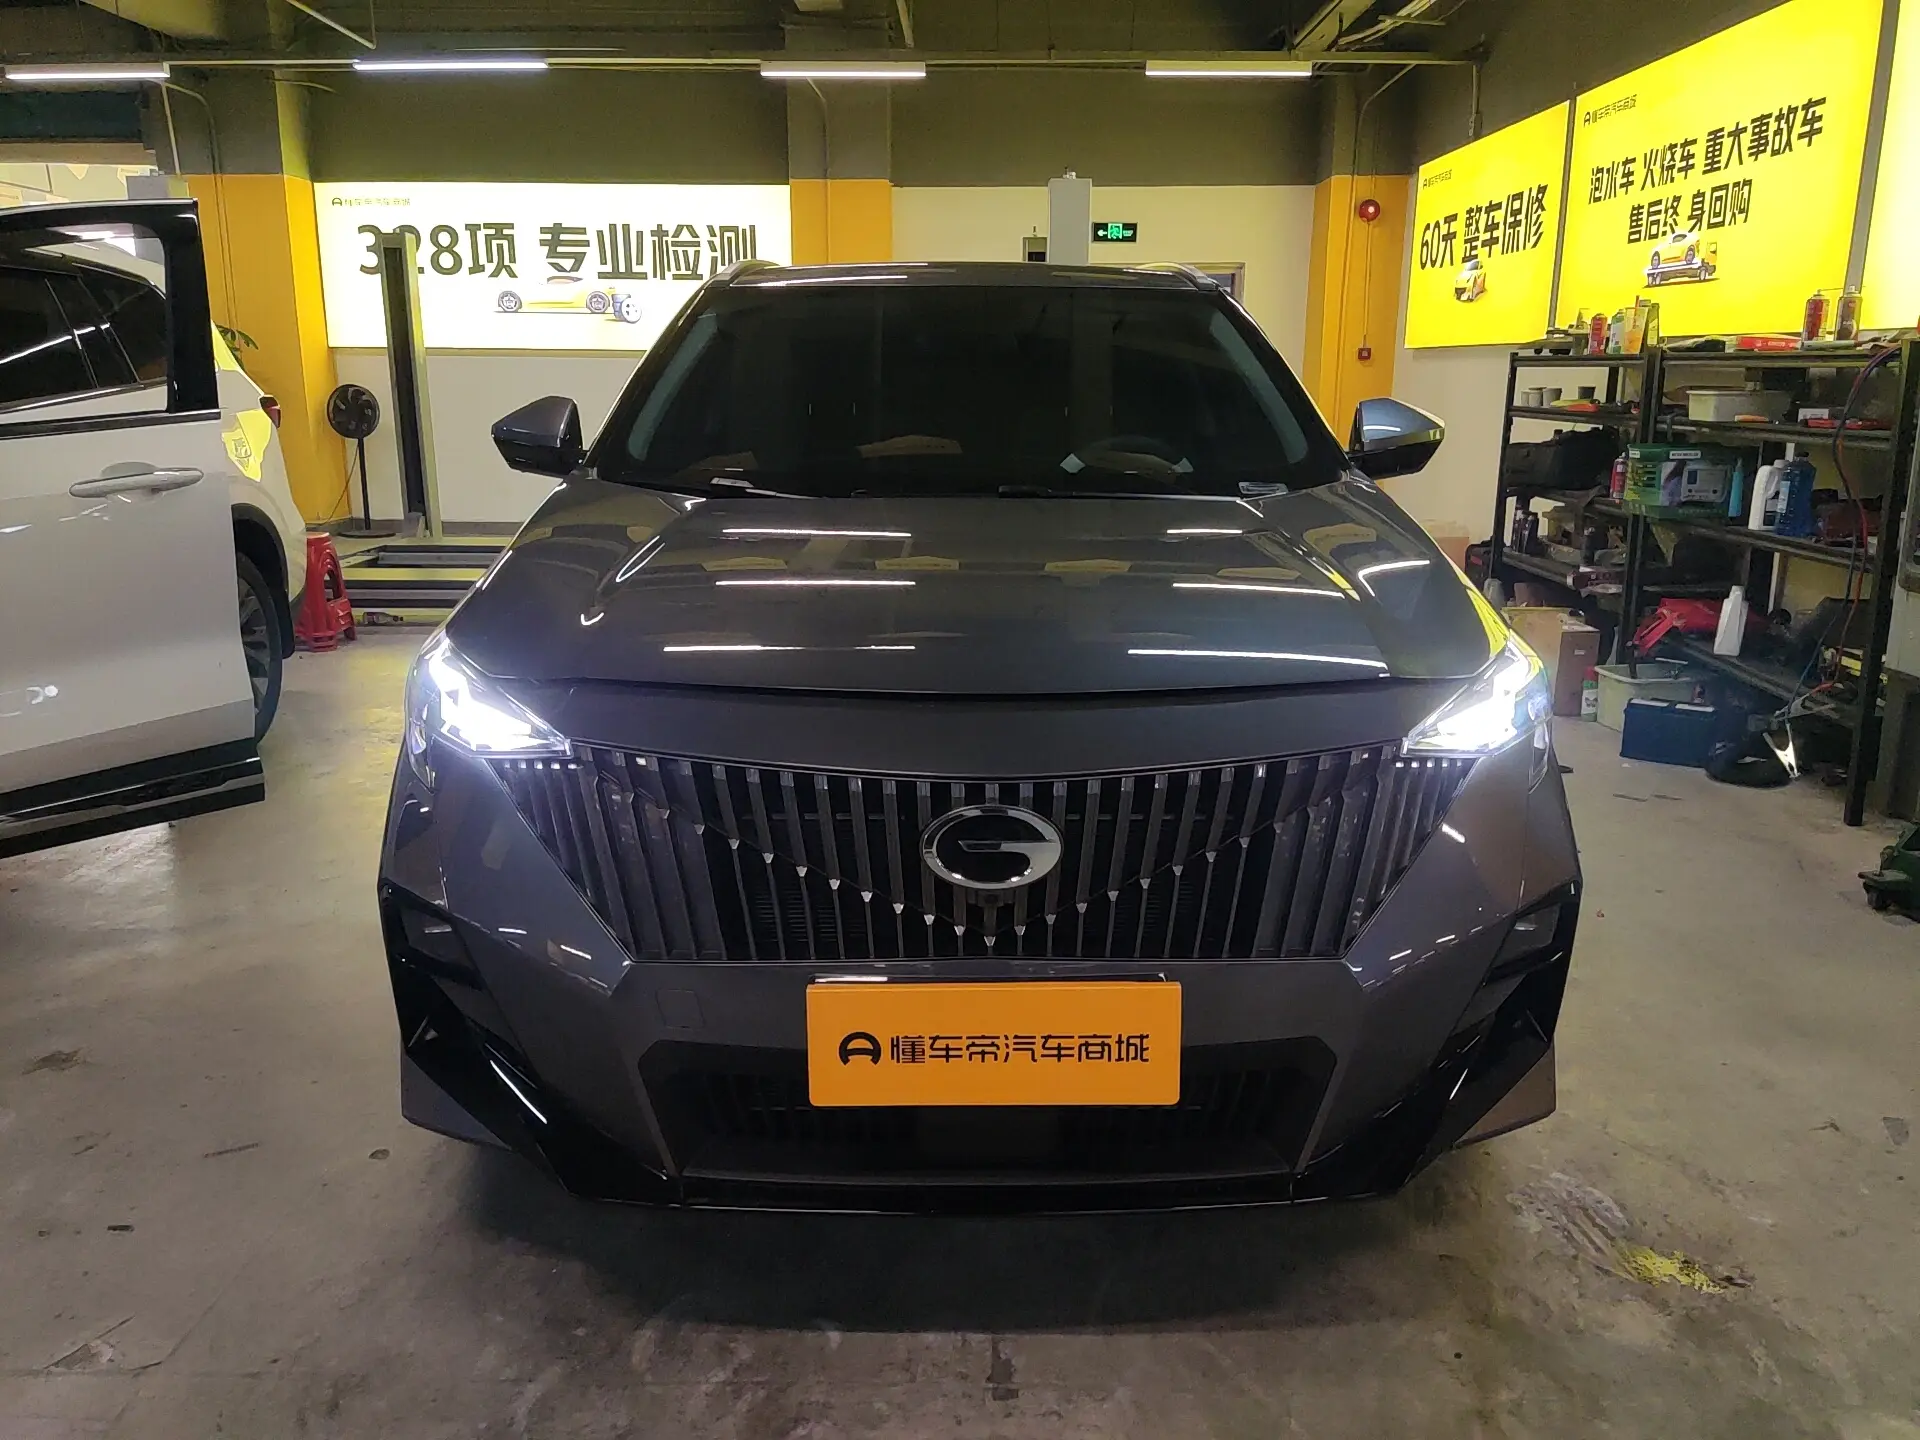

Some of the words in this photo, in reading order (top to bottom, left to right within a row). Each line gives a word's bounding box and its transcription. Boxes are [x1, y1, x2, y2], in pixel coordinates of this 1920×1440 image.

[1588, 156, 1637, 205] 泡水车
[1640, 137, 1699, 191] 火烧车
[1702, 96, 1827, 176] 重大事故车
[1419, 212, 1459, 270] 60天
[1461, 183, 1549, 264] 整车保修
[1627, 194, 1682, 244] 售后终
[1687, 178, 1753, 234] 身回购
[539, 222, 756, 281] 专业检测
[890, 1033, 1150, 1064] 懂车帝汽车商城
